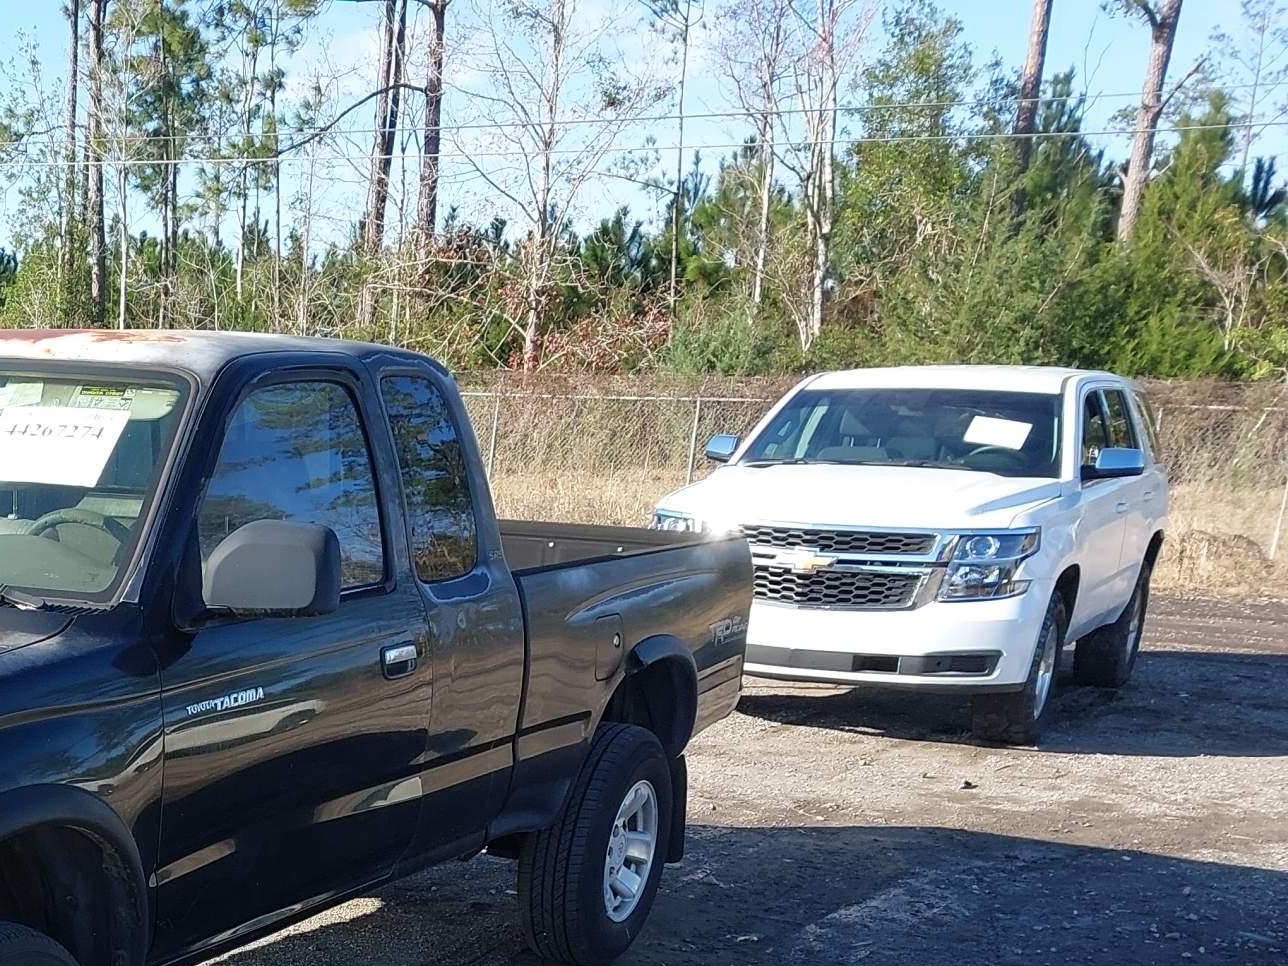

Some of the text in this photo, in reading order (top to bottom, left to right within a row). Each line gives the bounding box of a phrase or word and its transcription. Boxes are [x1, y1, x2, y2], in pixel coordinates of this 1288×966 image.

[4, 423, 105, 440] 44267274
[186, 687, 265, 715] TOYOTA TACOMA
